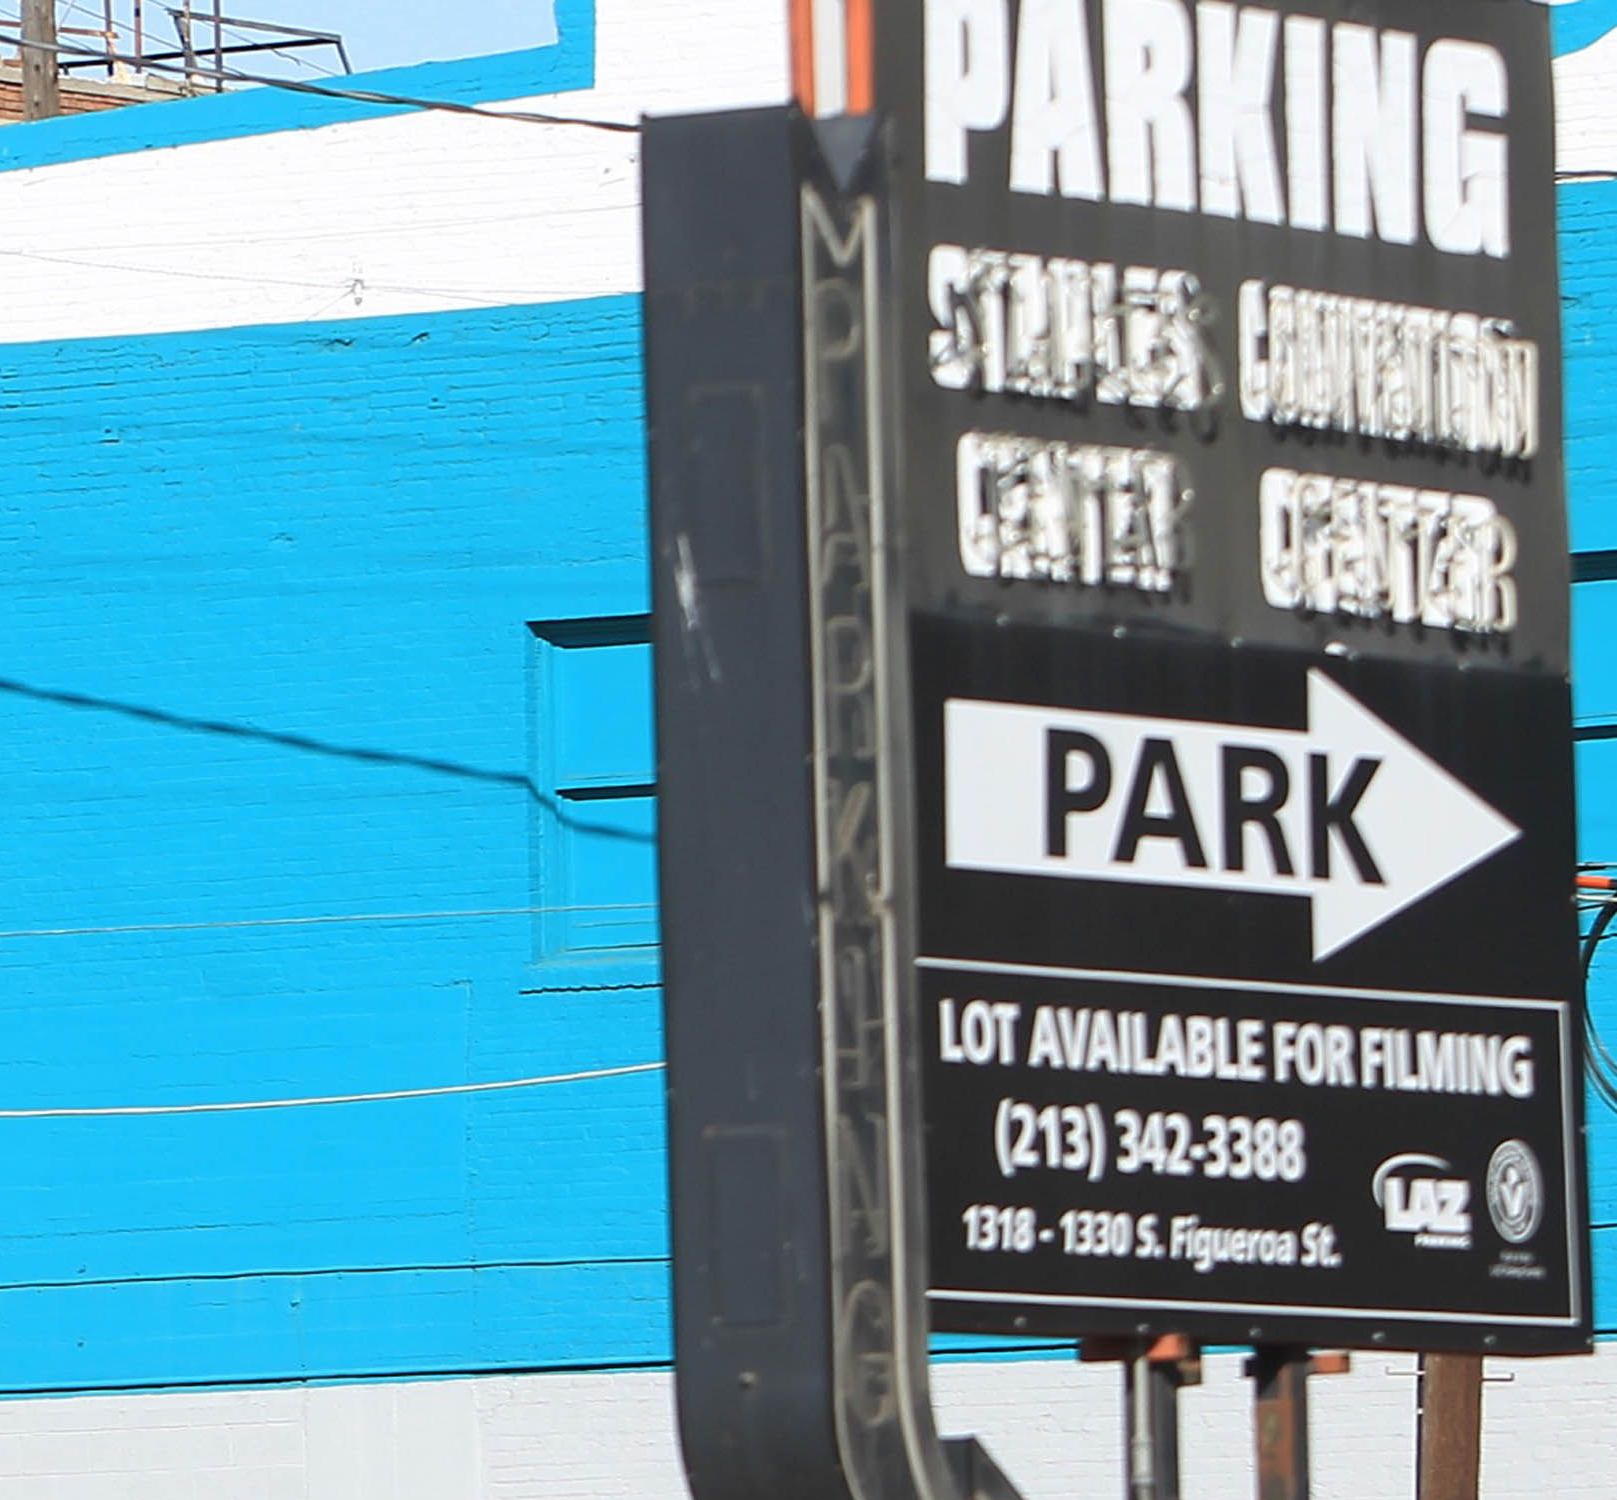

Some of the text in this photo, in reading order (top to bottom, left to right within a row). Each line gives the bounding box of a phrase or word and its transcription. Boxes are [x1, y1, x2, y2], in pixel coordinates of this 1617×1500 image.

[924, 0, 1509, 258] PARKING
[928, 244, 1217, 411] STAPLES
[1260, 467, 1518, 634] CENTER
[1045, 727, 1387, 887] PARK
[939, 999, 1534, 1099] LOT AVAILABLE FOR FILMING
[995, 1098, 1306, 1182] (213) 342-3388
[1383, 1176, 1473, 1234] LAZ
[962, 1204, 1037, 1254] 1318
[1059, 1209, 1132, 1257] 1330
[1135, 1213, 1166, 1260] S.
[1169, 1214, 1298, 1273] Figueroa
[1300, 1222, 1343, 1268] St.
